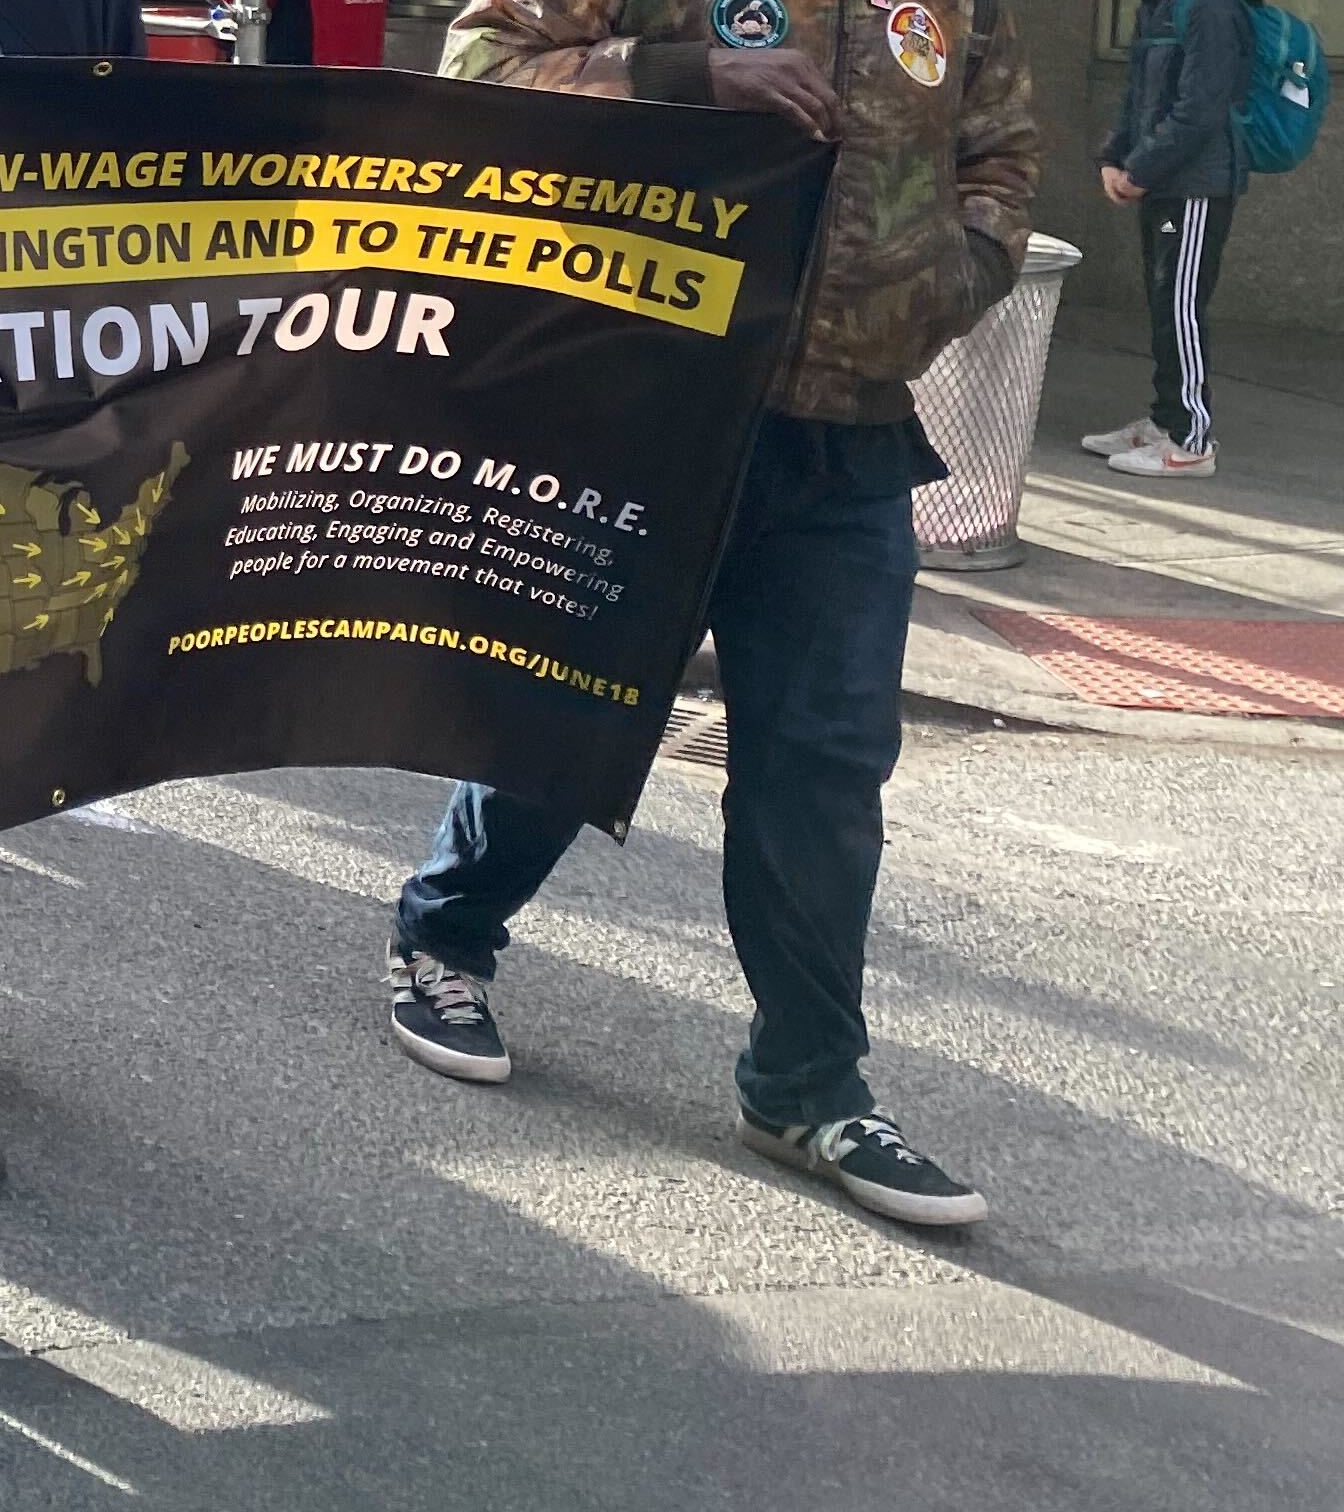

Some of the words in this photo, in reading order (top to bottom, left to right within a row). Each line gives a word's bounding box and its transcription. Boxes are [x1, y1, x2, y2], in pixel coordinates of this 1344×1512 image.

[201, 151, 463, 194] WORKERS'
[463, 166, 749, 240] ASSEMBLY
[205, 218, 313, 262] AND
[332, 219, 399, 255] TO
[416, 224, 516, 269] THE
[526, 238, 707, 311] POLLS
[236, 287, 456, 357] TOUR
[231, 445, 279, 481] WE
[284, 441, 394, 475] MUST
[398, 445, 462, 480] DO
[472, 458, 650, 538] M.O.R.E.
[240, 489, 341, 515] Mobilizing,
[348, 490, 473, 524] Organizing,
[482, 506, 615, 569] Registering,
[224, 520, 319, 549] Educating,
[325, 520, 423, 548] Engaging
[428, 525, 475, 551] and
[480, 538, 625, 603] Empowering
[228, 551, 293, 581] people
[296, 548, 330, 576] for
[333, 553, 346, 569] a
[352, 551, 470, 582] movement
[475, 566, 524, 596] that
[529, 585, 600, 621] votes!
[167, 618, 640, 707] POORPEOPLESCAMPAIGN.ORG/JUNE18
